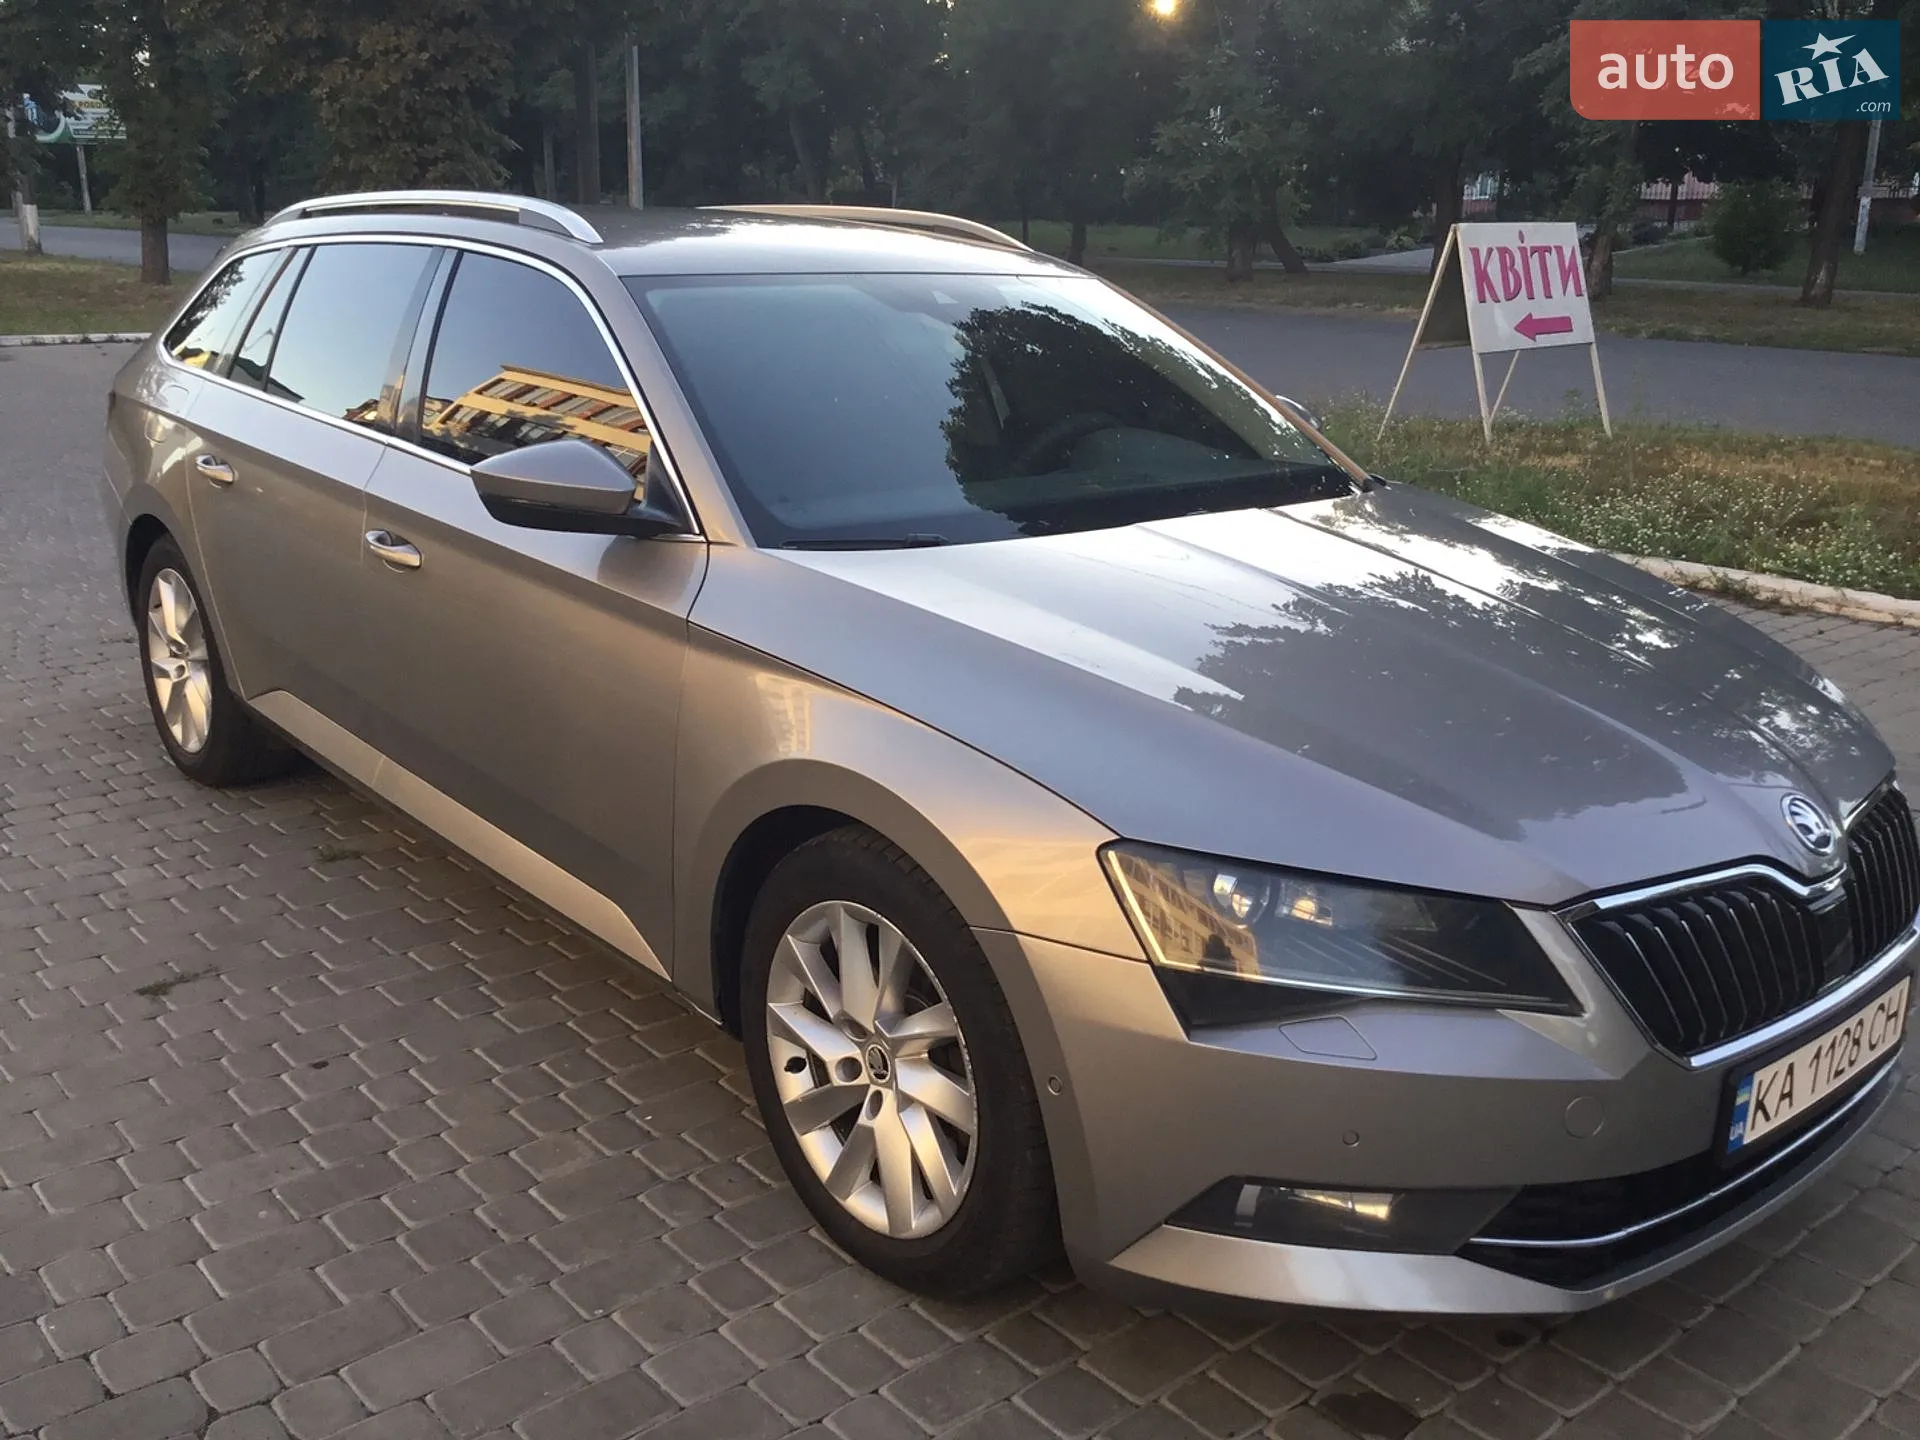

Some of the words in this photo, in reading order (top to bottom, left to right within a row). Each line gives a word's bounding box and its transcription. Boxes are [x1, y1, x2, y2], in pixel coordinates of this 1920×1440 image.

[1468, 229, 1585, 304] КВІТИ
[1750, 1062, 1795, 1130] KA
[1809, 1018, 1864, 1095] 1128
[1868, 988, 1903, 1051] CH
